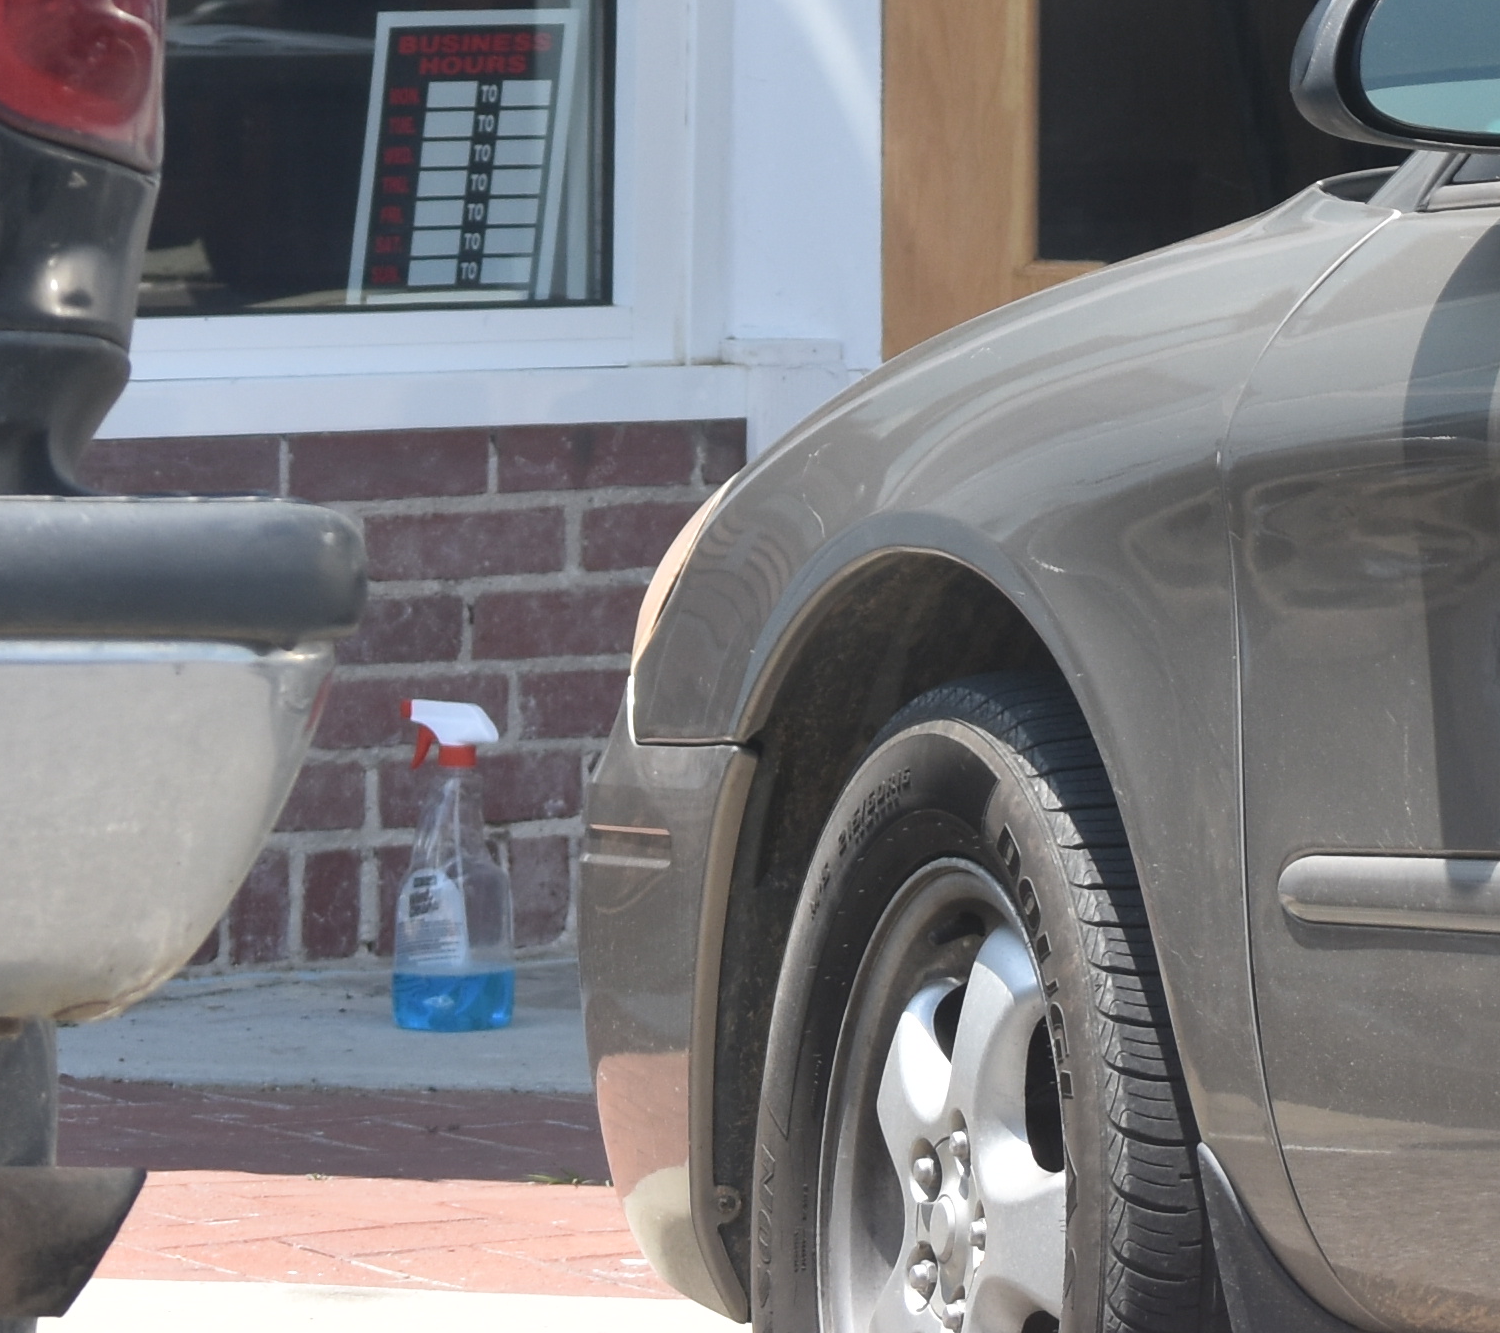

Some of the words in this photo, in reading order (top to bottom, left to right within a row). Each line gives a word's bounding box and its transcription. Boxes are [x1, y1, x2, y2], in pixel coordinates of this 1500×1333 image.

[398, 32, 551, 55] BUSINESS
[419, 54, 528, 76] HOURS
[480, 84, 498, 102] TO
[477, 114, 495, 132] TO
[473, 143, 491, 162] TO
[470, 173, 488, 191] TO
[466, 202, 484, 221] TO
[463, 232, 481, 251] TO
[460, 261, 478, 280] TO
